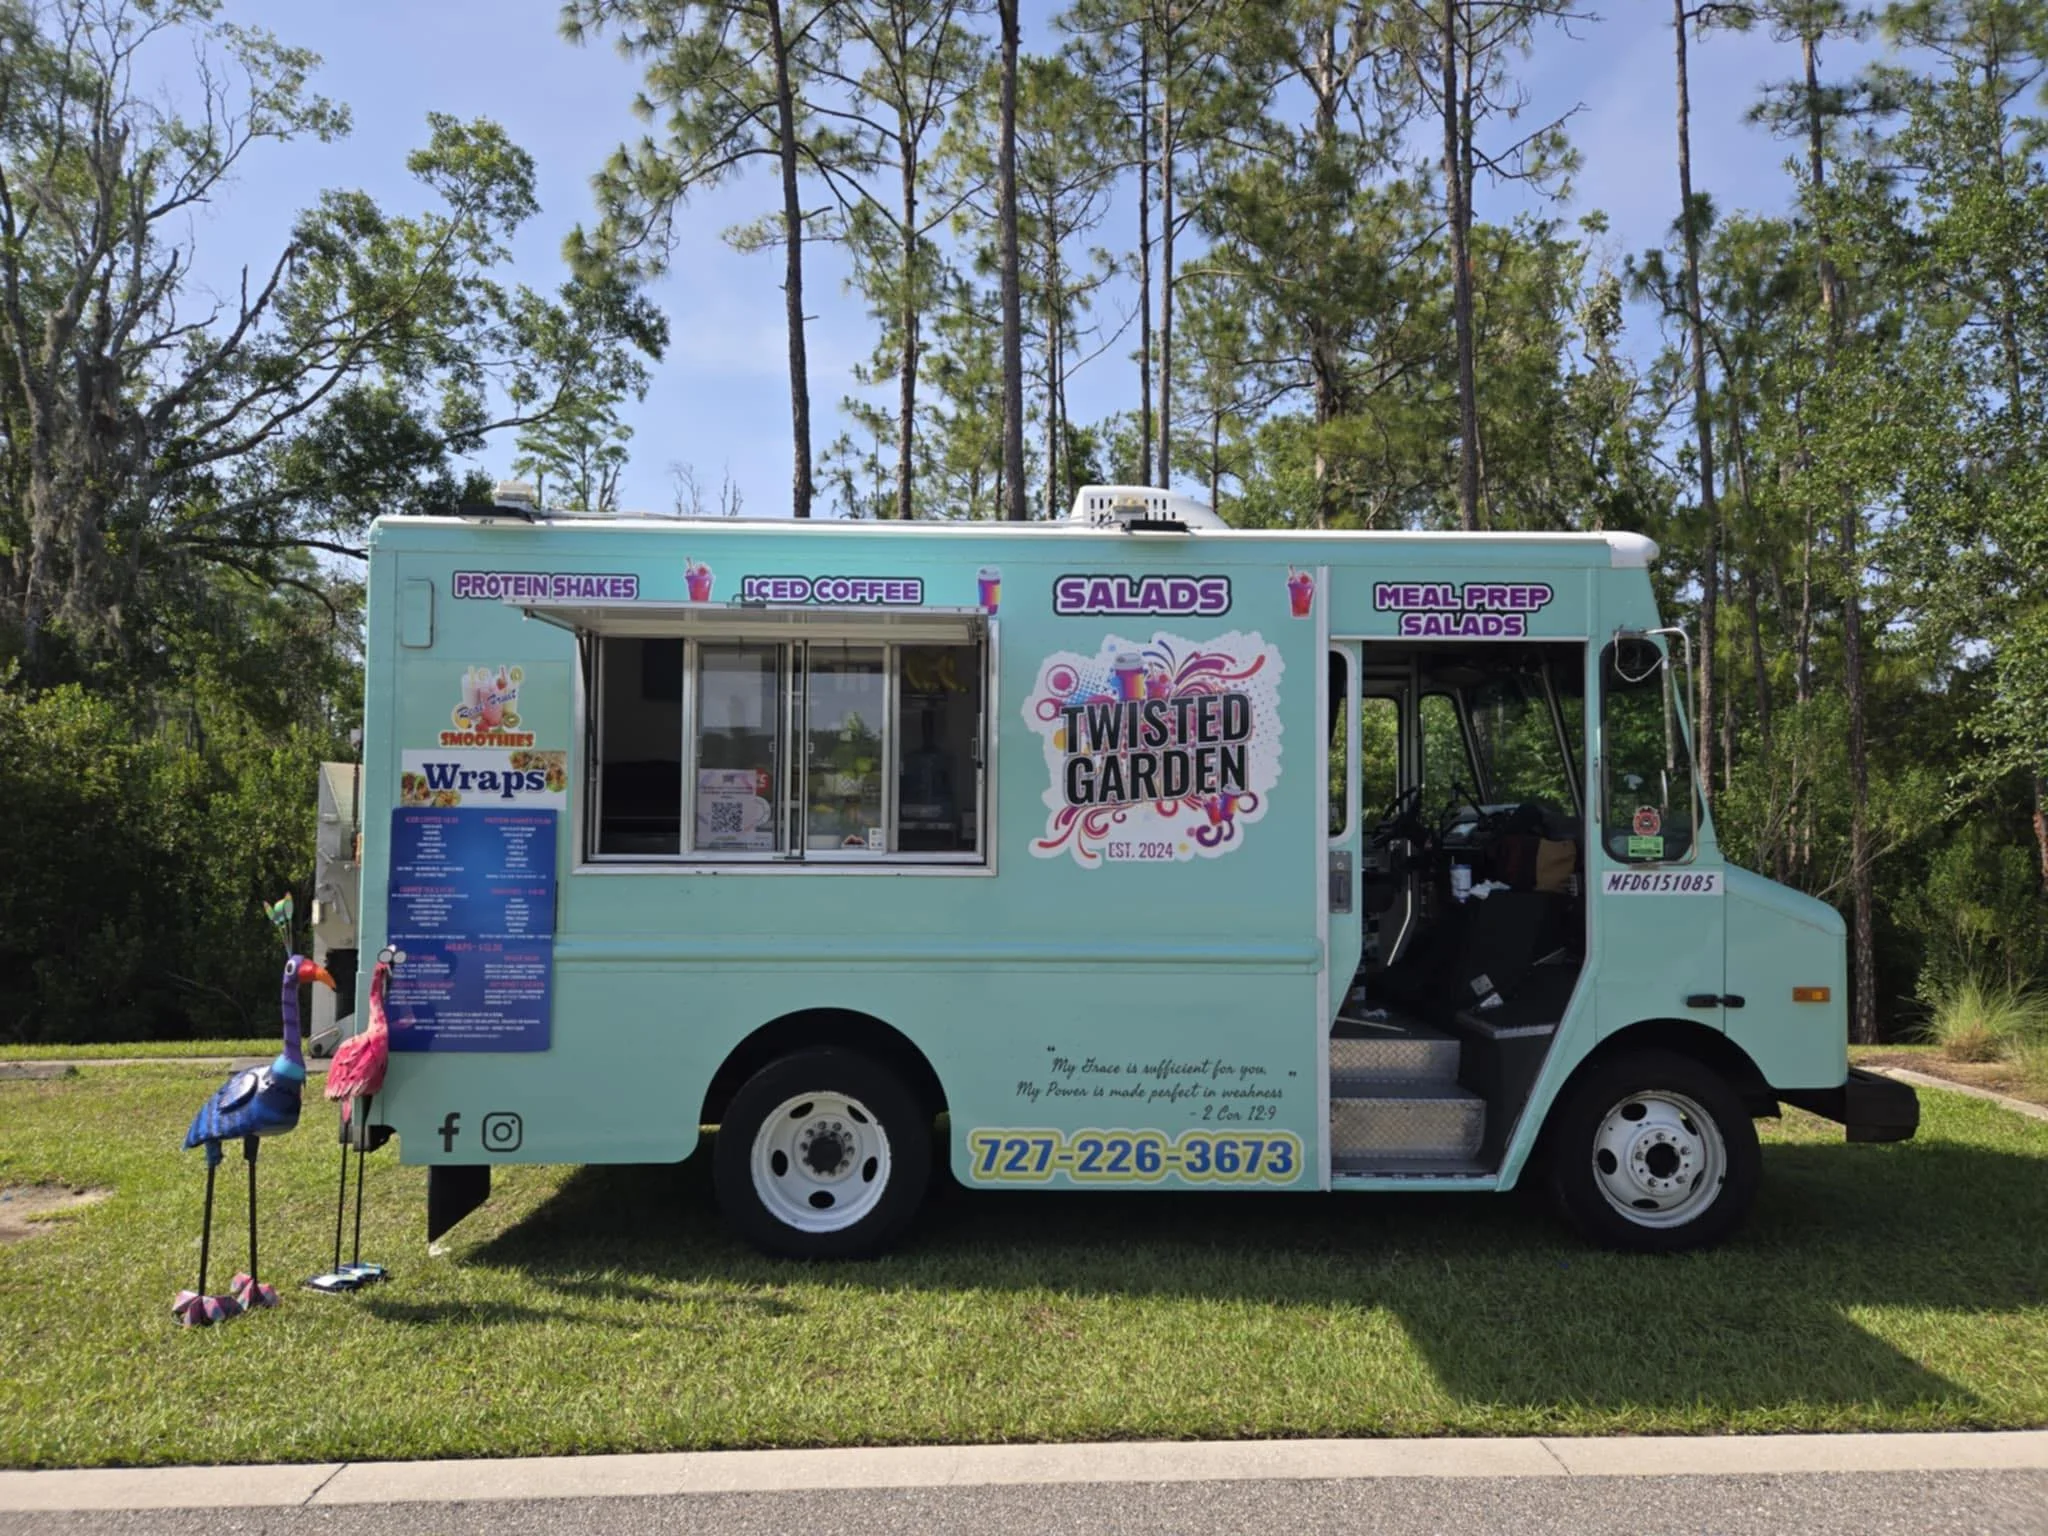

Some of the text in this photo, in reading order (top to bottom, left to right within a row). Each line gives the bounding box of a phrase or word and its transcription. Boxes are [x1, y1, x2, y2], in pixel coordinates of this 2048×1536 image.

[455, 573, 637, 599] PROTEIN SHAKES
[744, 579, 922, 603] ICED COFFEE
[1057, 578, 1228, 611] SALADS
[1377, 585, 1550, 609] MEAL PREP
[1401, 614, 1524, 636] SALADS
[1061, 692, 1251, 754] TWISTED
[439, 731, 535, 748] SMOOTHIES
[422, 763, 546, 799] Wraps
[1066, 744, 1246, 805] GARDEN
[1108, 842, 1174, 859] EST. 2024
[1607, 873, 1716, 892] MFD6151085
[1051, 1057, 1076, 1080] My
[1081, 1056, 1121, 1074] Grace
[1126, 1062, 1137, 1074] is
[1142, 1058, 1212, 1080] sufficient
[1212, 1059, 1235, 1080] for
[1016, 1080, 1284, 1104] My Power is made perfect in weakness
[1202, 1104, 1213, 1121] 2
[1217, 1104, 1241, 1121] Cor
[976, 1136, 1297, 1177] 727-226-3673
